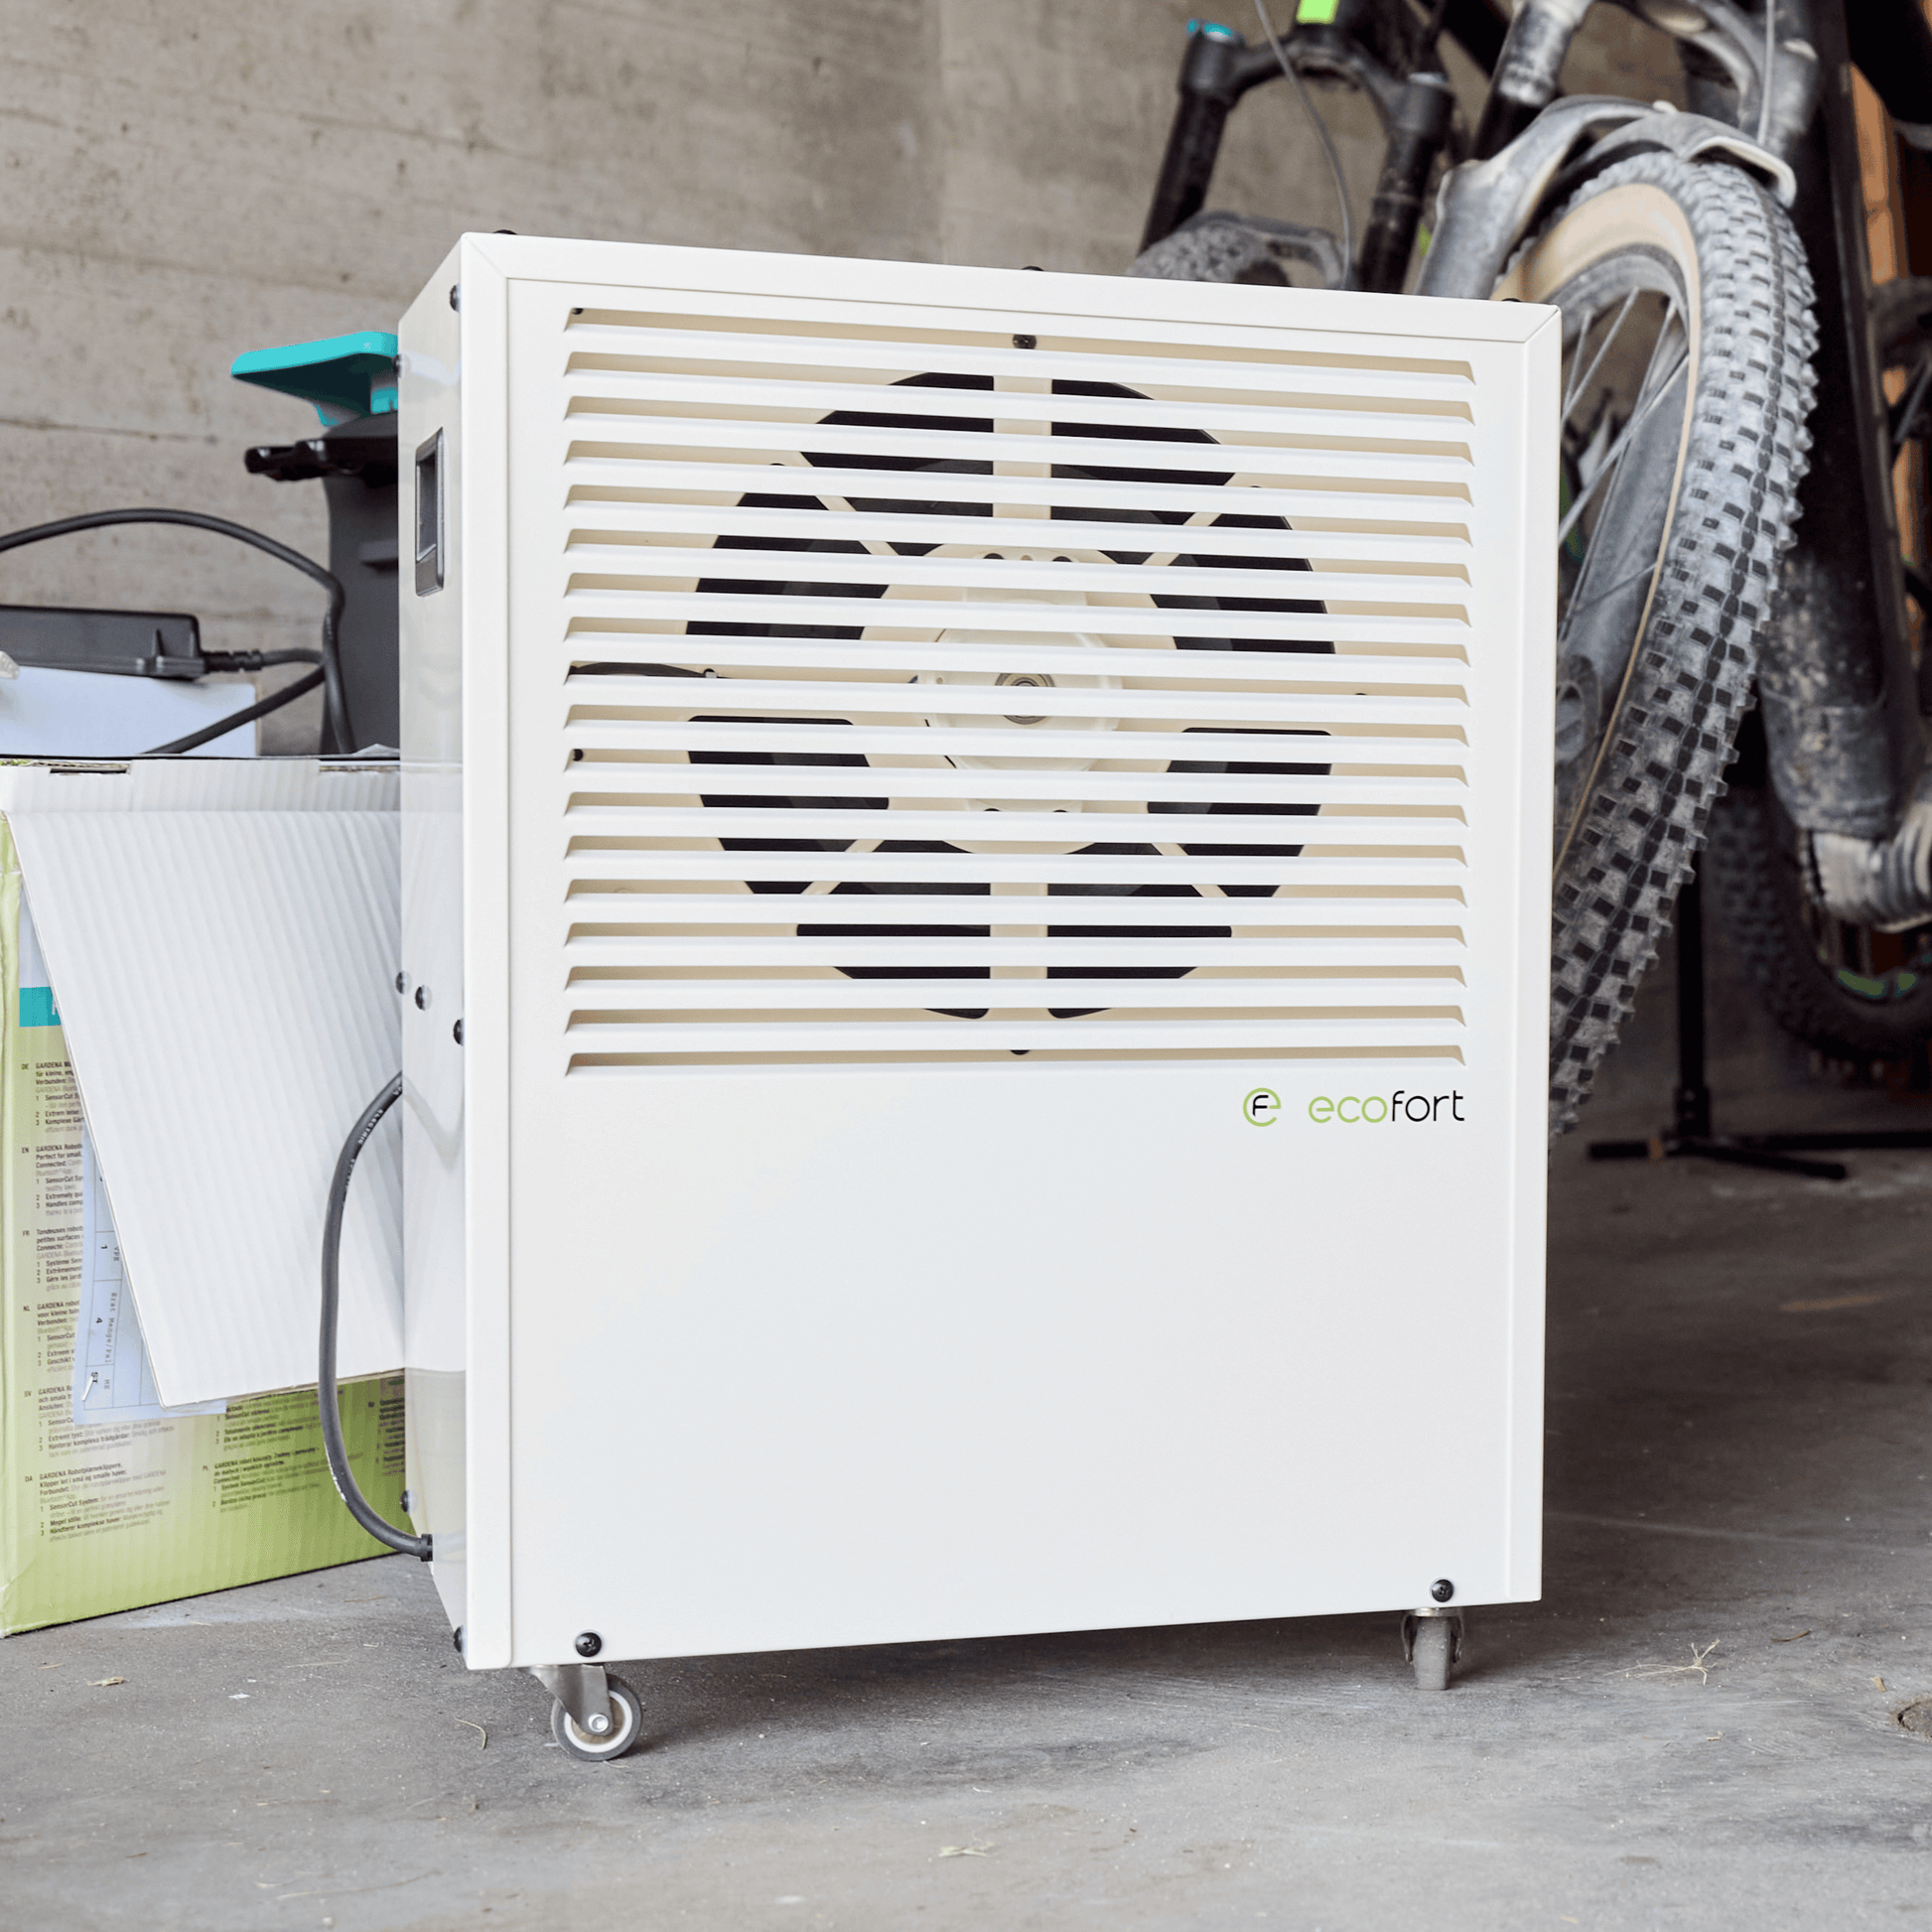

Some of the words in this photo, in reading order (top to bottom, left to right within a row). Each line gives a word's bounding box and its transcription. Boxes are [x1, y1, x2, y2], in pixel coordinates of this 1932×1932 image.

[1308, 1090, 1465, 1123] ecofort
[38, 1386, 64, 1395] GARDENA
[40, 1471, 66, 1480] GARDENA
[50, 1501, 77, 1511] SensorCut
